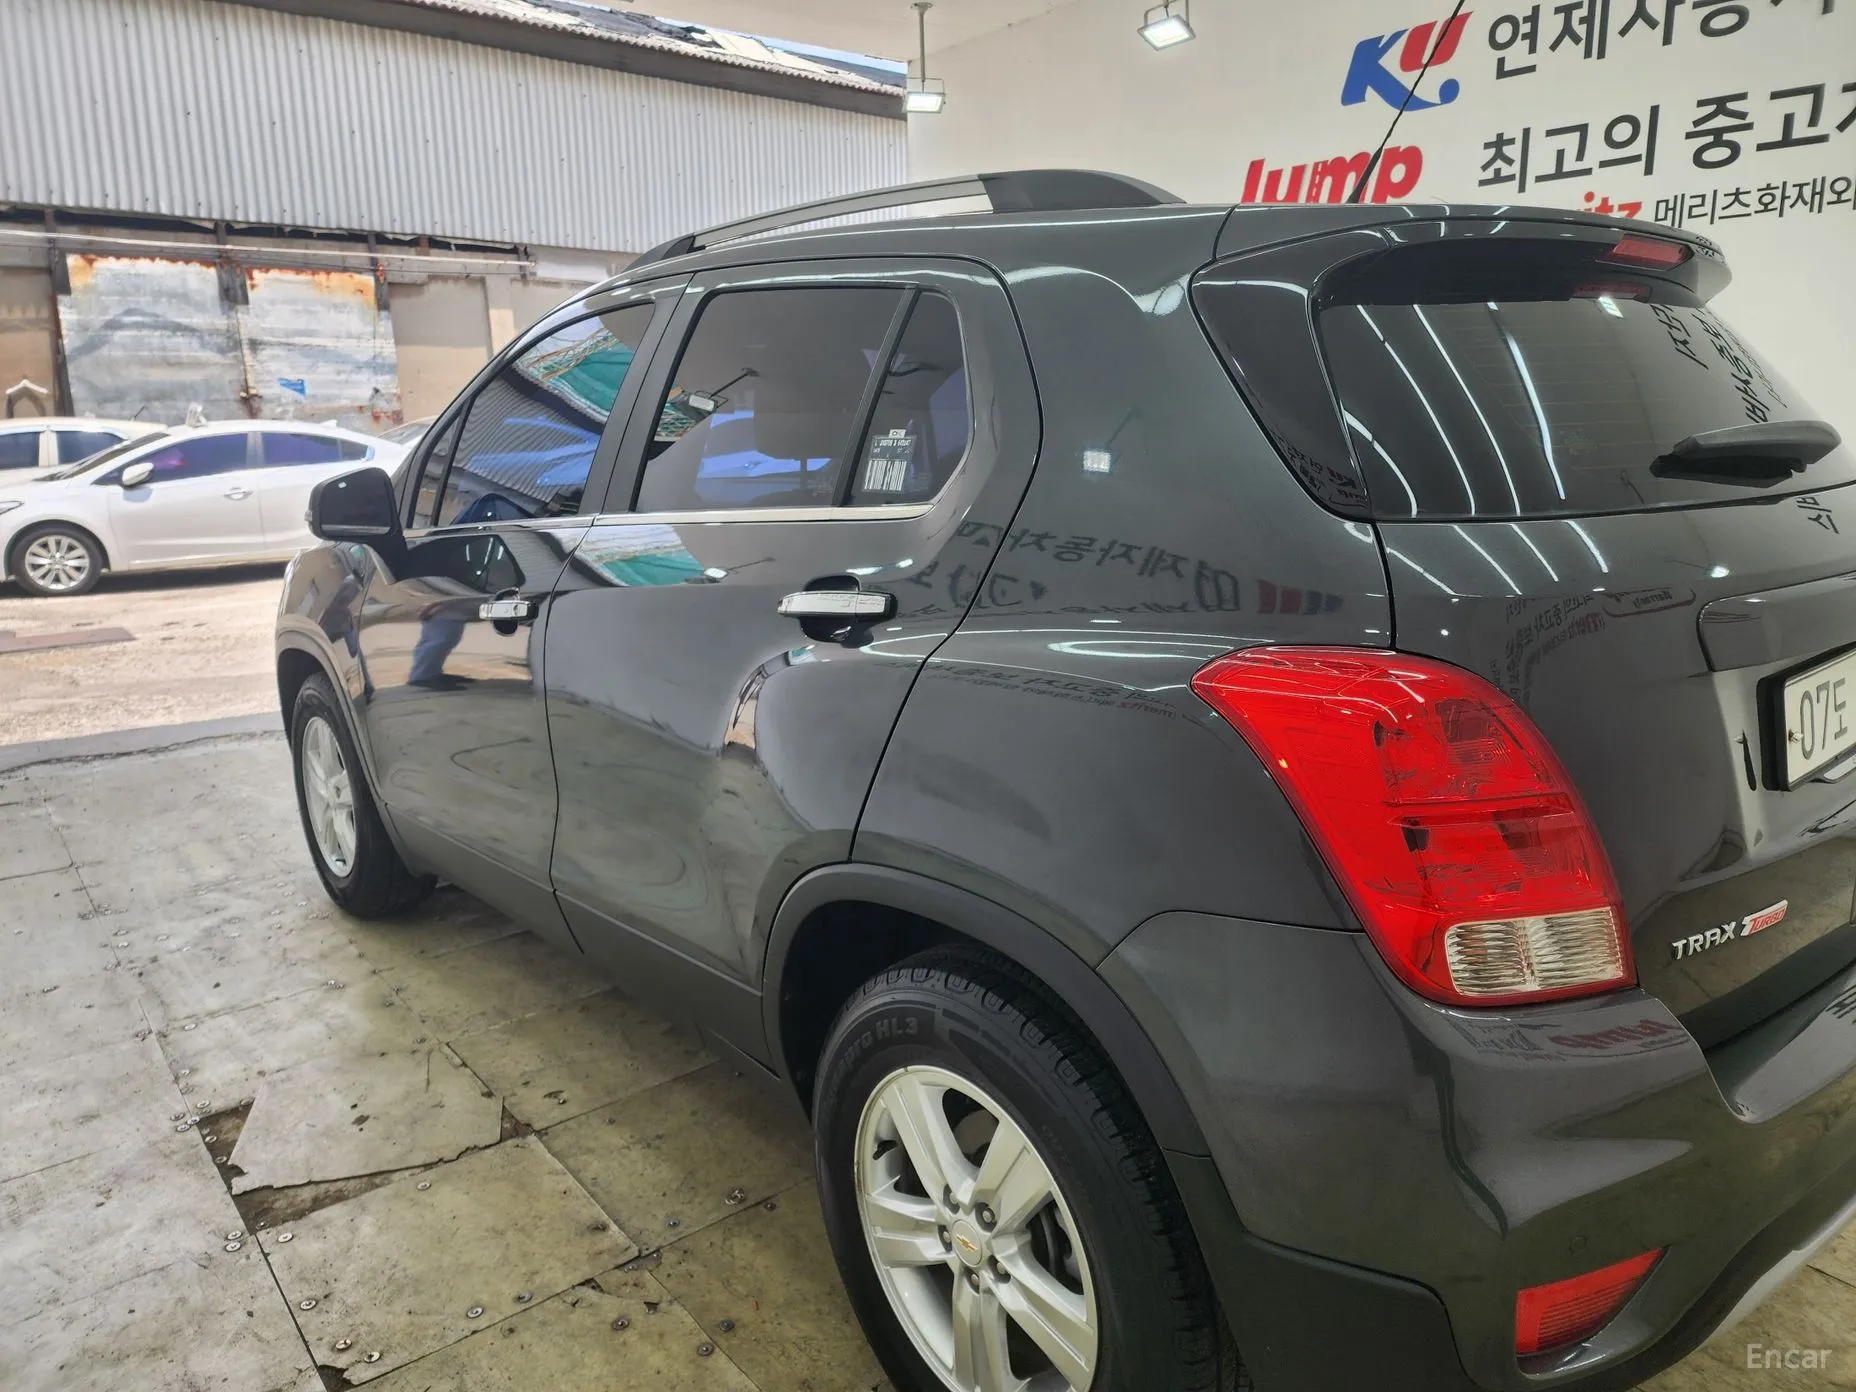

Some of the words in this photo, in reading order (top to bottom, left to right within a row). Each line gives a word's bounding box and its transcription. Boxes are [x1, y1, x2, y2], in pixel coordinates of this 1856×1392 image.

[1477, 104, 1660, 194] 최고의
[1672, 921, 1737, 960] TRAX
[1741, 900, 1788, 937] TURBO
